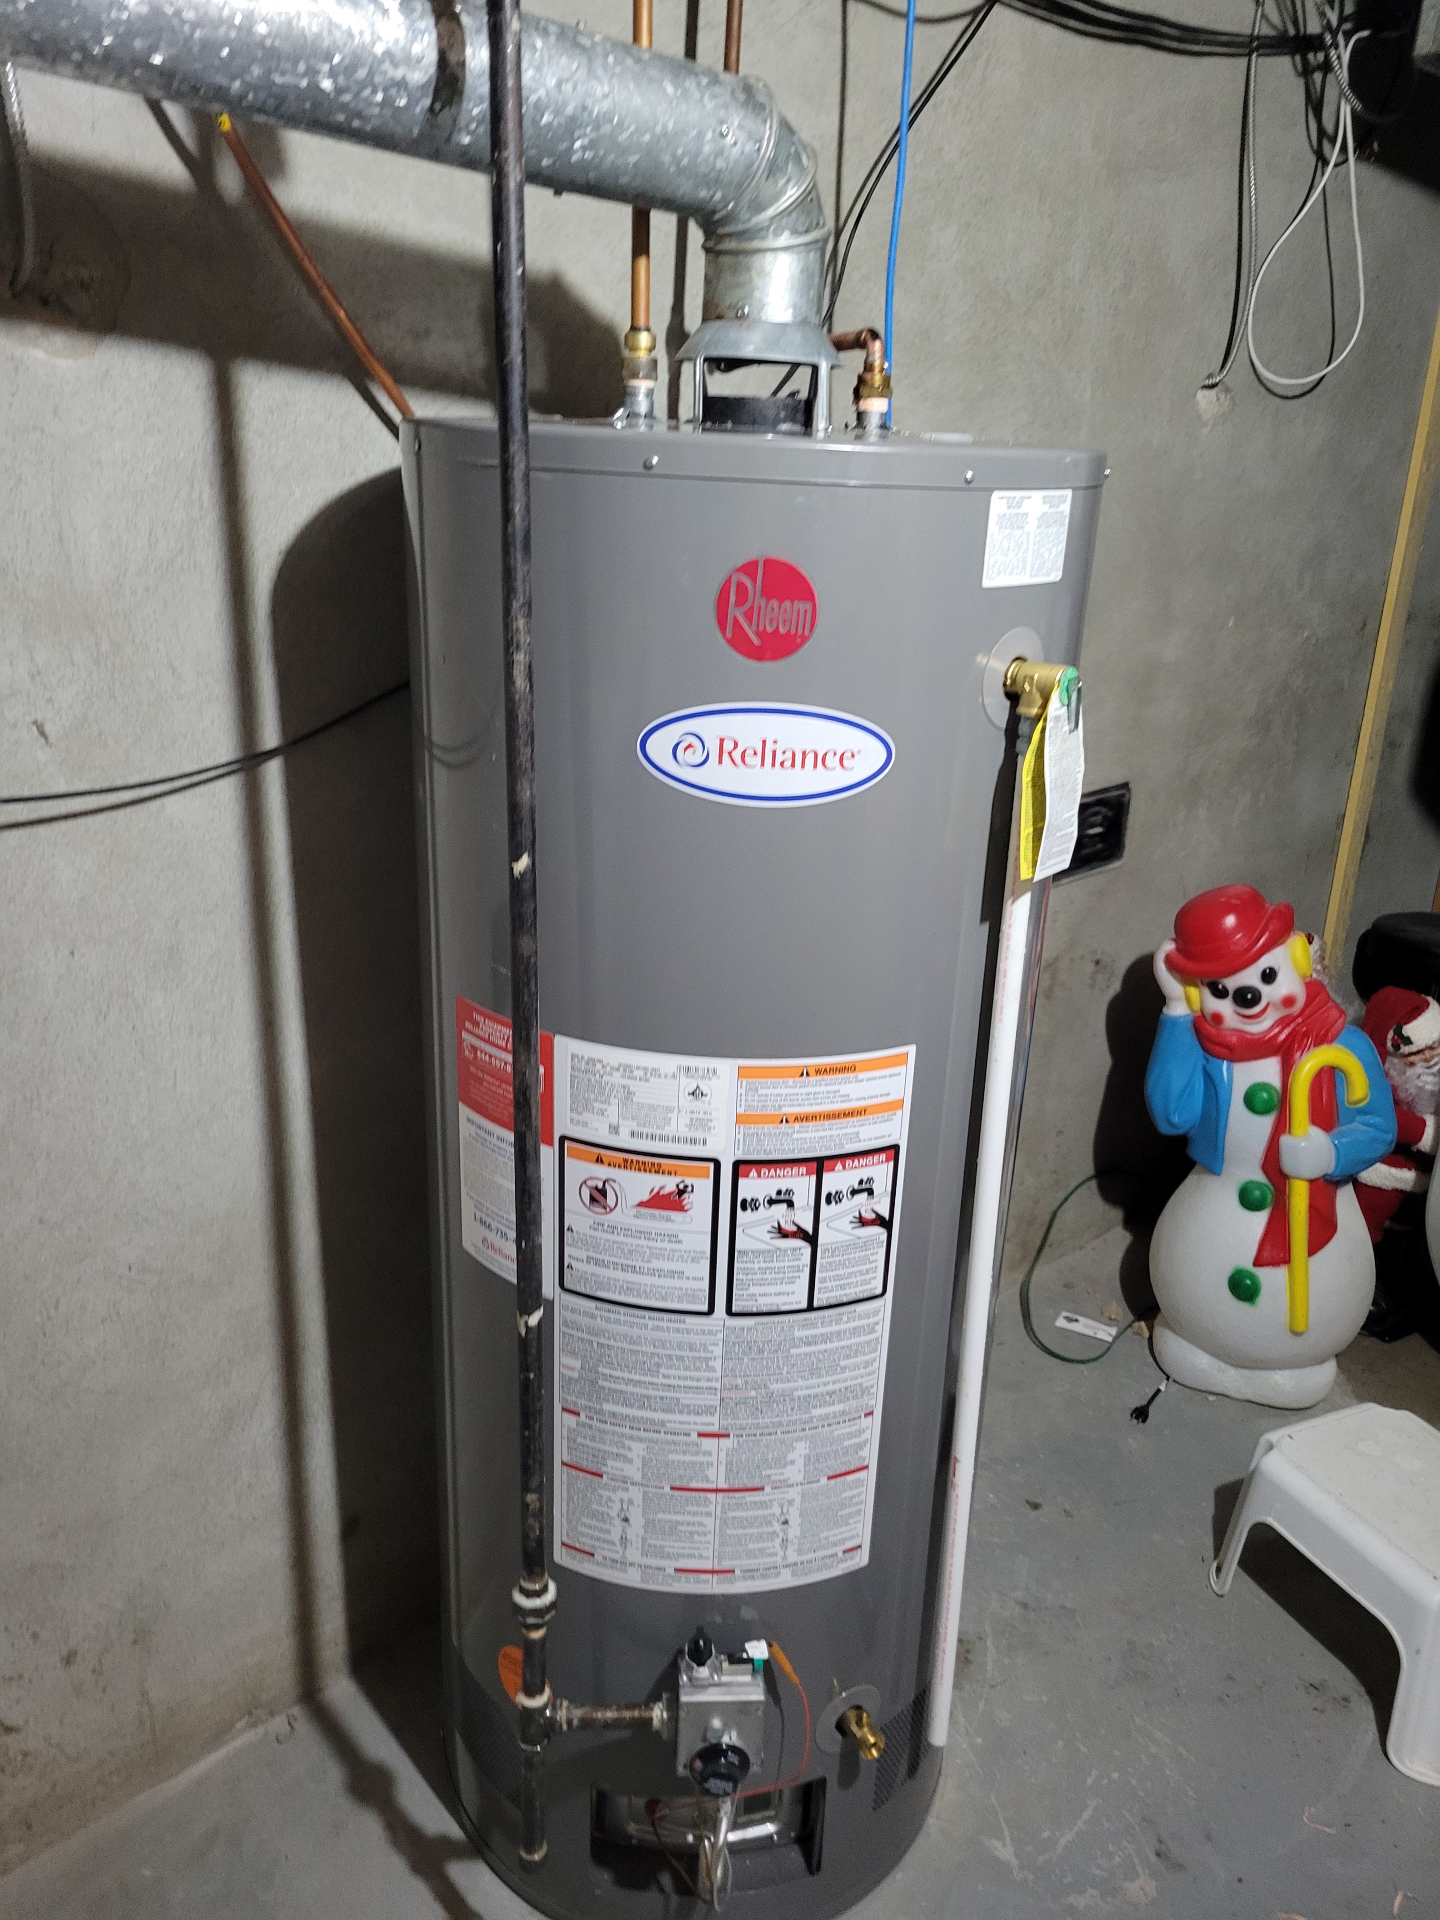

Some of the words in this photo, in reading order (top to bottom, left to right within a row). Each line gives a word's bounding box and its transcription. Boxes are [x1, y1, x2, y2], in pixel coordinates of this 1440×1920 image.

[726, 555, 813, 646] Rheem
[716, 735, 857, 771] Reliance
[814, 1064, 857, 1076] WARNING
[793, 1108, 868, 1123] AVERTISSEMENT
[622, 1157, 662, 1169] WARNING
[845, 1153, 886, 1170] DANGER
[607, 1162, 678, 1177] AVERTISSEMENT
[760, 1166, 807, 1178] DANGER
